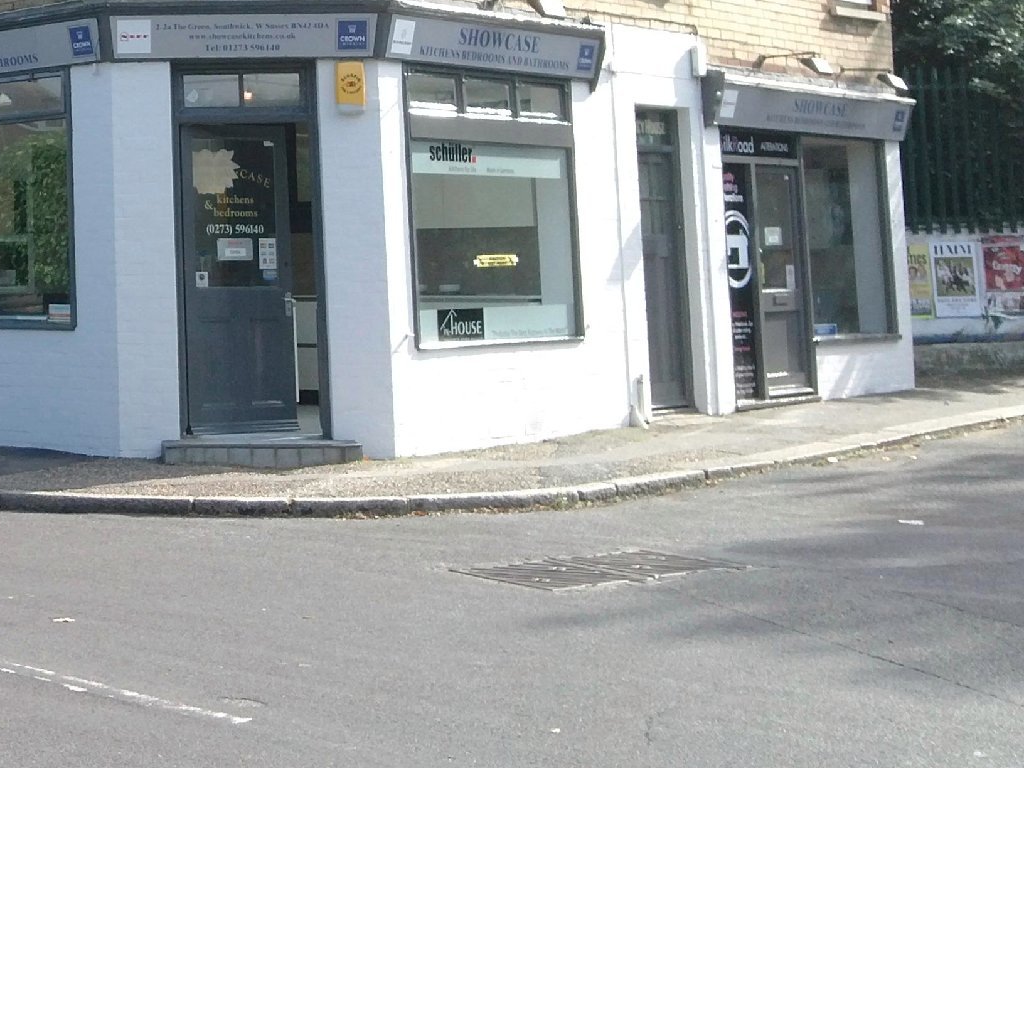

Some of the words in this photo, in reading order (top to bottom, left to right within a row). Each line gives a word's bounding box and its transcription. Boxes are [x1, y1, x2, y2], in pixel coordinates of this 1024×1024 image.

[339, 35, 366, 43] CROWN
[459, 28, 541, 53] SHOWCASE
[419, 45, 461, 59] KITCHENS
[462, 50, 506, 64] BEDROOMS
[508, 55, 523, 66] AND
[525, 57, 570, 71] BATHROOMS
[794, 99, 848, 118] SHOWCASE
[204, 198, 214, 211] &
[216, 194, 255, 204] kitchens
[213, 208, 258, 217] bedrooms
[206, 224, 233, 236] (0273)
[235, 224, 265, 234] 596140
